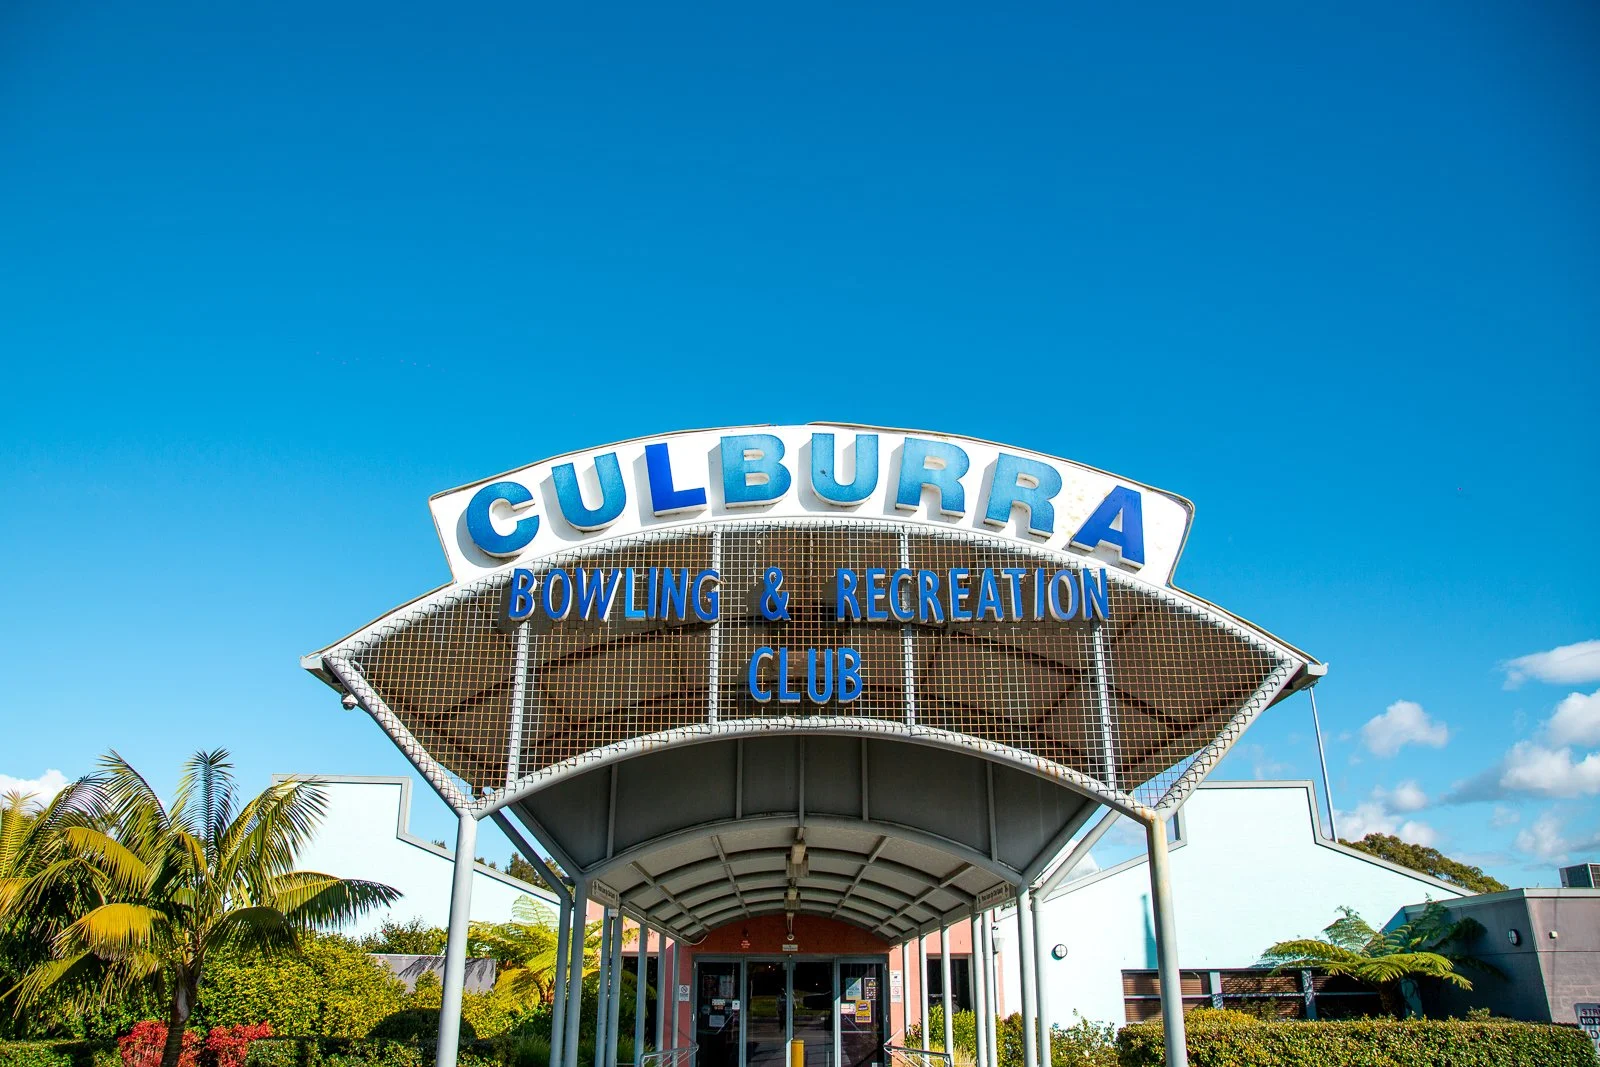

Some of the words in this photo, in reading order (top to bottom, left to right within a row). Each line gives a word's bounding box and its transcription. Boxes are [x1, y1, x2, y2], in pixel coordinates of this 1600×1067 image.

[466, 433, 1146, 567] CULBURRA
[508, 567, 721, 622] BOWLING
[759, 566, 791, 621] &
[836, 567, 1109, 622] RECREATION
[749, 647, 863, 704] CLUB
